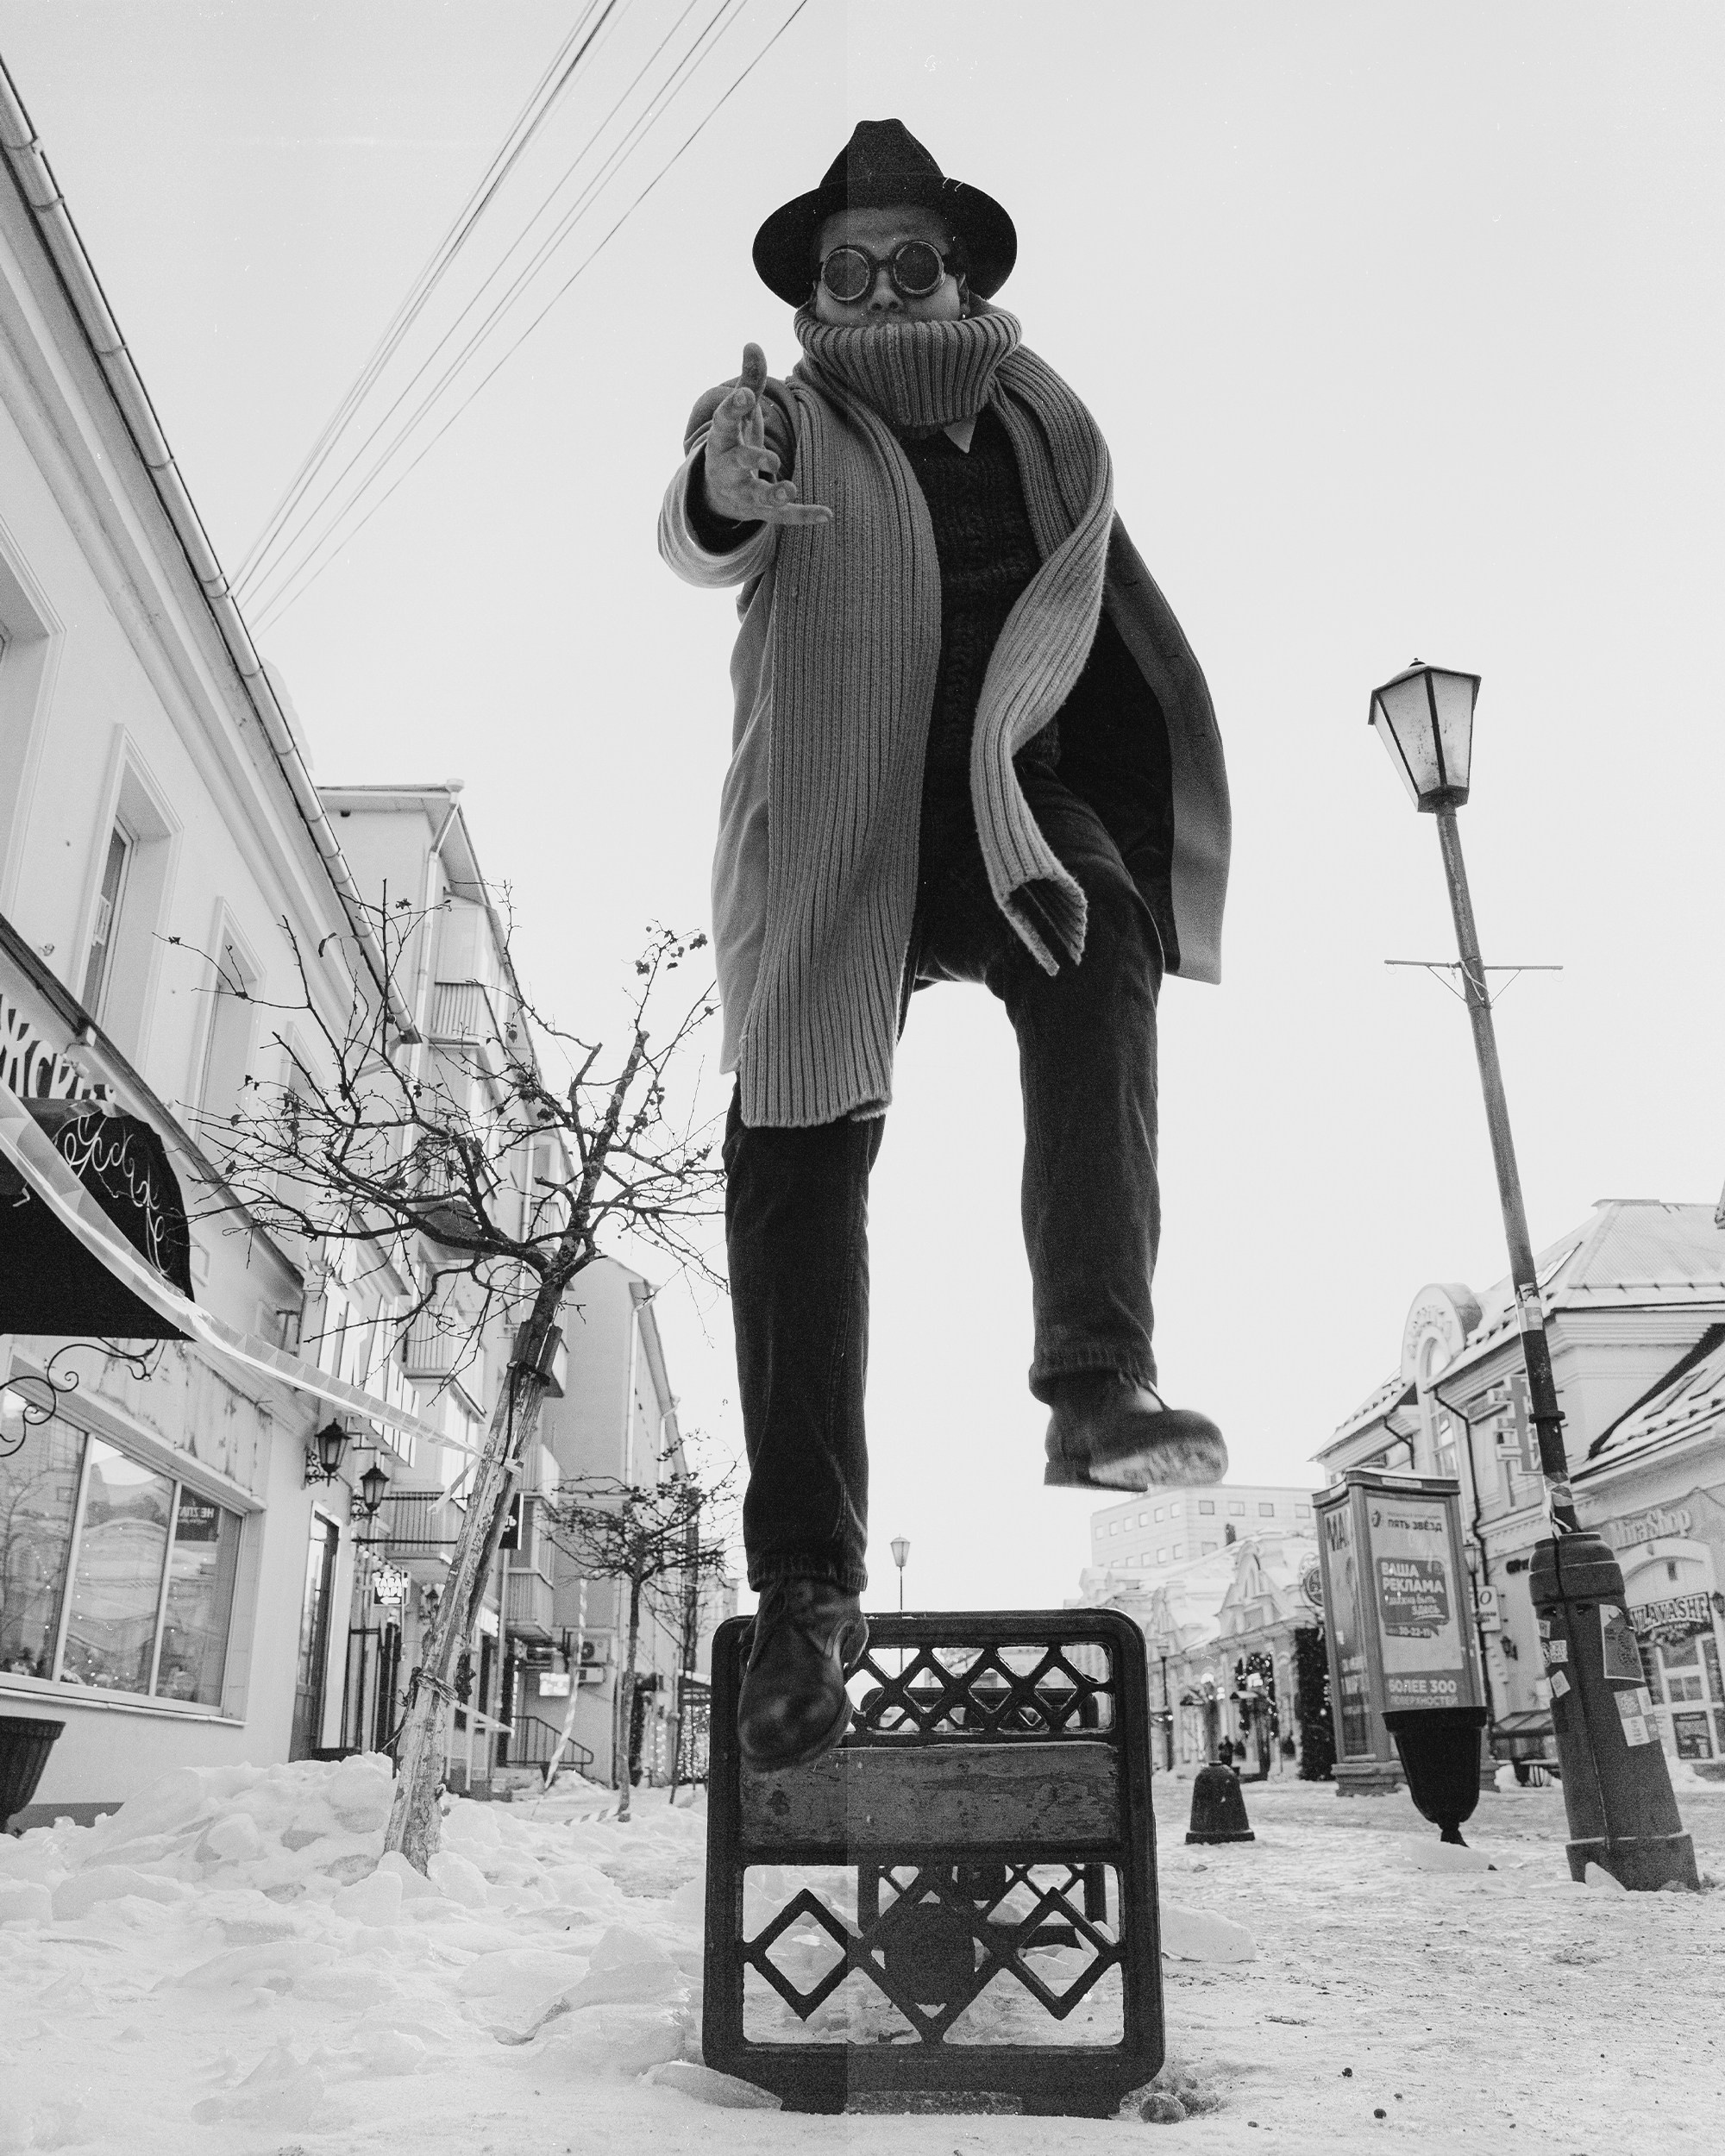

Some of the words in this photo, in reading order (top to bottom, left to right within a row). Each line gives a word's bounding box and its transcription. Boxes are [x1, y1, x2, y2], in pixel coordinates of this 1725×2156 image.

[1388, 1519, 1410, 1530] ПЯТЬ
[1381, 1562, 1419, 1577] ВАША
[1383, 1576, 1445, 1594] РЕКЛАМА
[1389, 1679, 1427, 1693] БОЛЕЕ
[1429, 1679, 1458, 1693] 300
